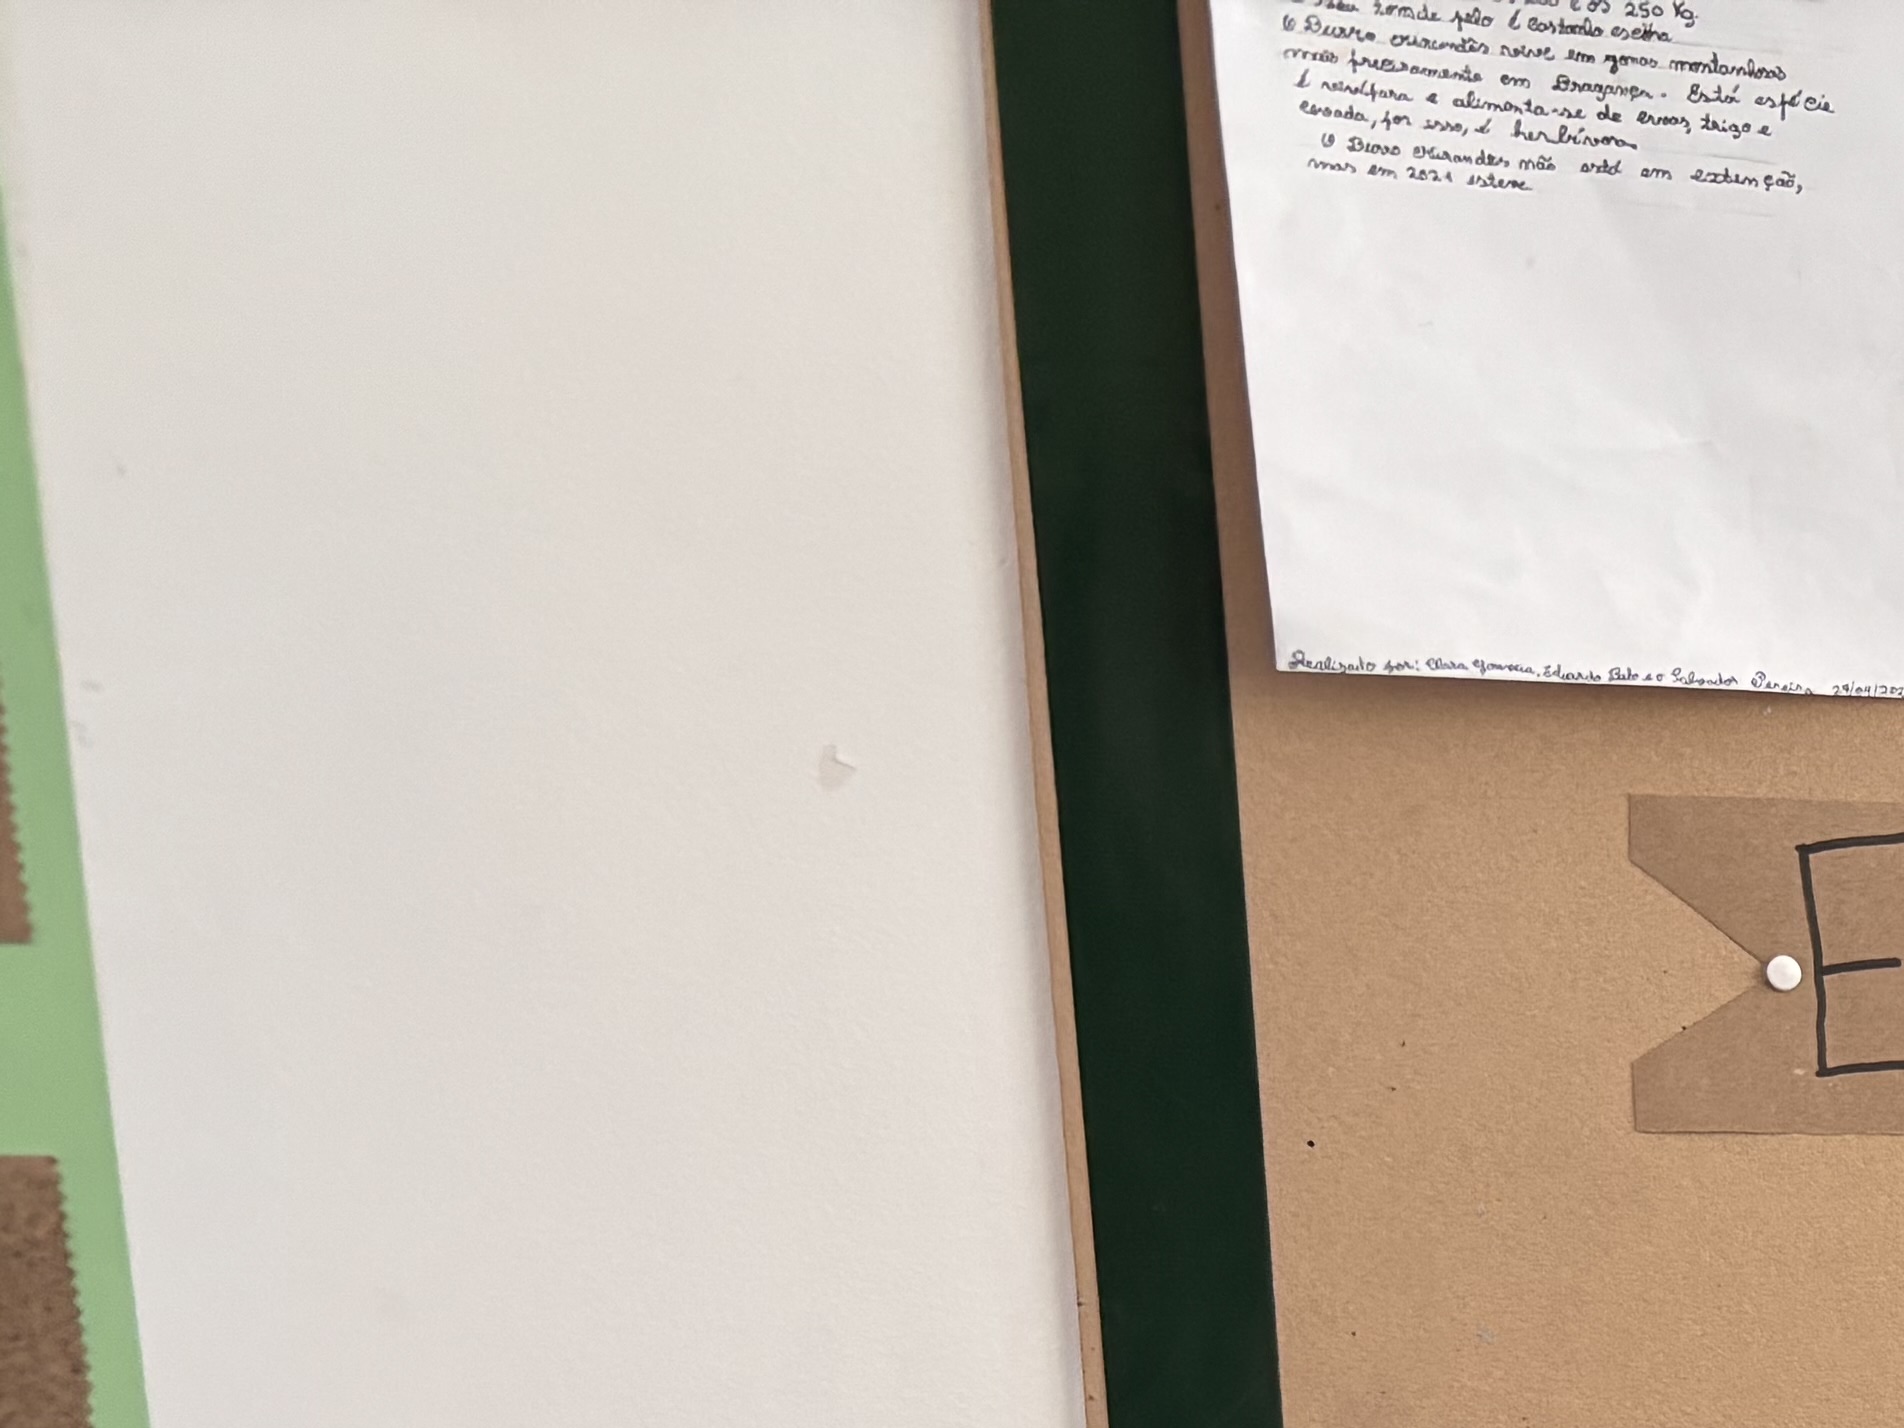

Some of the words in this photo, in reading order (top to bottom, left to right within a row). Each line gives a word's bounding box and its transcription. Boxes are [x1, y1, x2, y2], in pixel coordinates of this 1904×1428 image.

[1625, 2, 1664, 18] 250
[1565, 49, 1596, 64] em
[1500, 73, 1531, 89] em
[1382, 111, 1412, 131] por
[1597, 104, 1622, 123] de
[1701, 114, 1751, 139] trigo
[1757, 124, 1772, 136] e
[1308, 158, 1356, 174] mas
[1367, 165, 1397, 180] em
[1641, 166, 1672, 180] em
